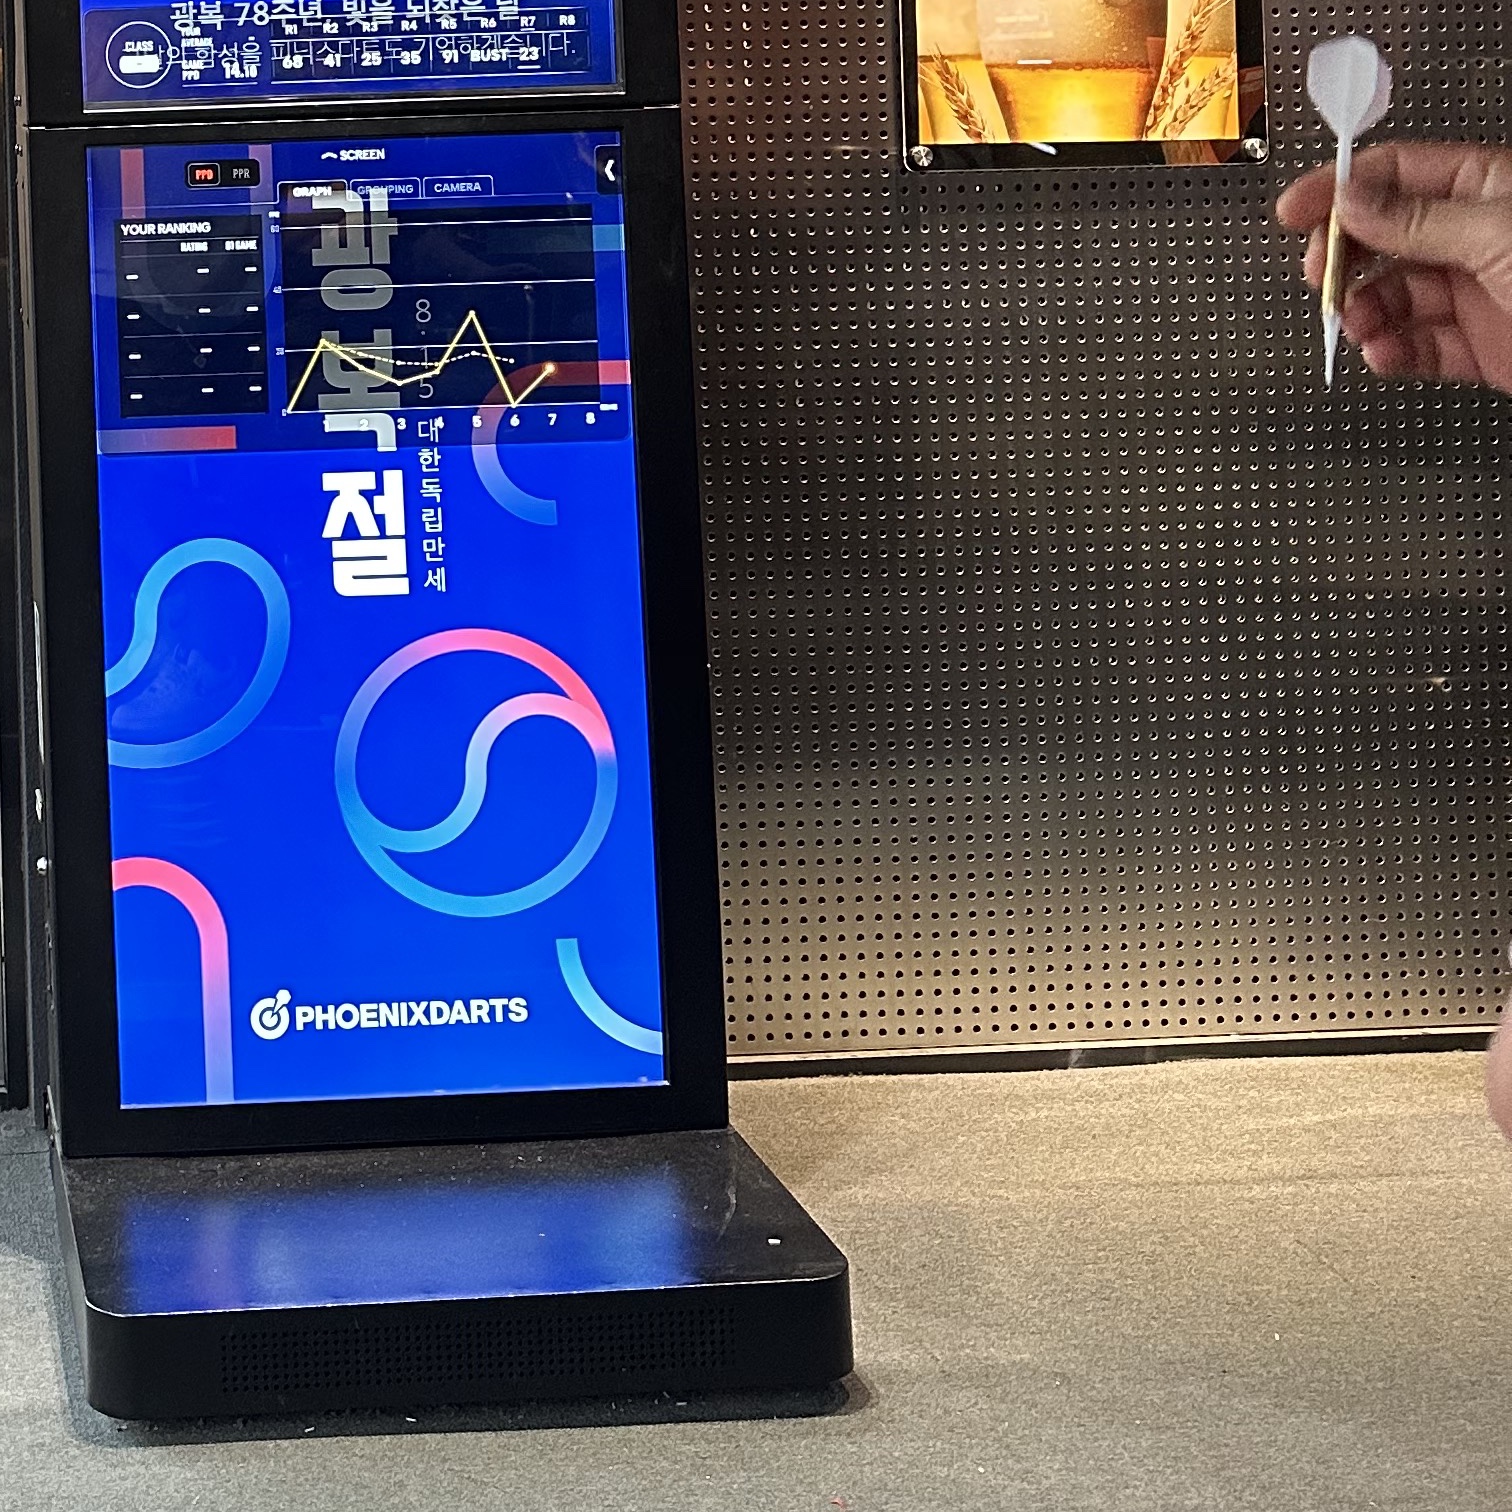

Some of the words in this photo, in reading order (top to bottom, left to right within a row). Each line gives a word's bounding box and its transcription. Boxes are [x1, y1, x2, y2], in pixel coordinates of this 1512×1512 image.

[170, 0, 224, 32] 광복
[285, 24, 298, 35] R1
[362, 21, 379, 32] R3
[401, 20, 418, 31] R4
[441, 18, 457, 29] R5
[480, 17, 497, 28] R6
[520, 15, 536, 27] R7
[559, 14, 576, 26] R8
[124, 40, 154, 52] CLASS
[361, 51, 383, 66] 25
[400, 50, 422, 65] 35
[442, 49, 459, 63] 91
[470, 48, 507, 62] BUST
[519, 47, 539, 61] 23
[339, 148, 386, 161] SCREEN
[232, 168, 251, 179] PPR
[292, 186, 332, 197] GRAPH
[356, 183, 414, 196] GROUPING
[434, 182, 482, 193] CAMERA
[121, 224, 157, 236] YOUR
[157, 222, 211, 235] RANKING
[397, 418, 406, 429] 3
[472, 416, 482, 427] 5
[510, 414, 520, 426] 6
[548, 413, 557, 425] 7
[586, 412, 596, 424] 8
[295, 997, 529, 1031] PHOENIXDARTS
